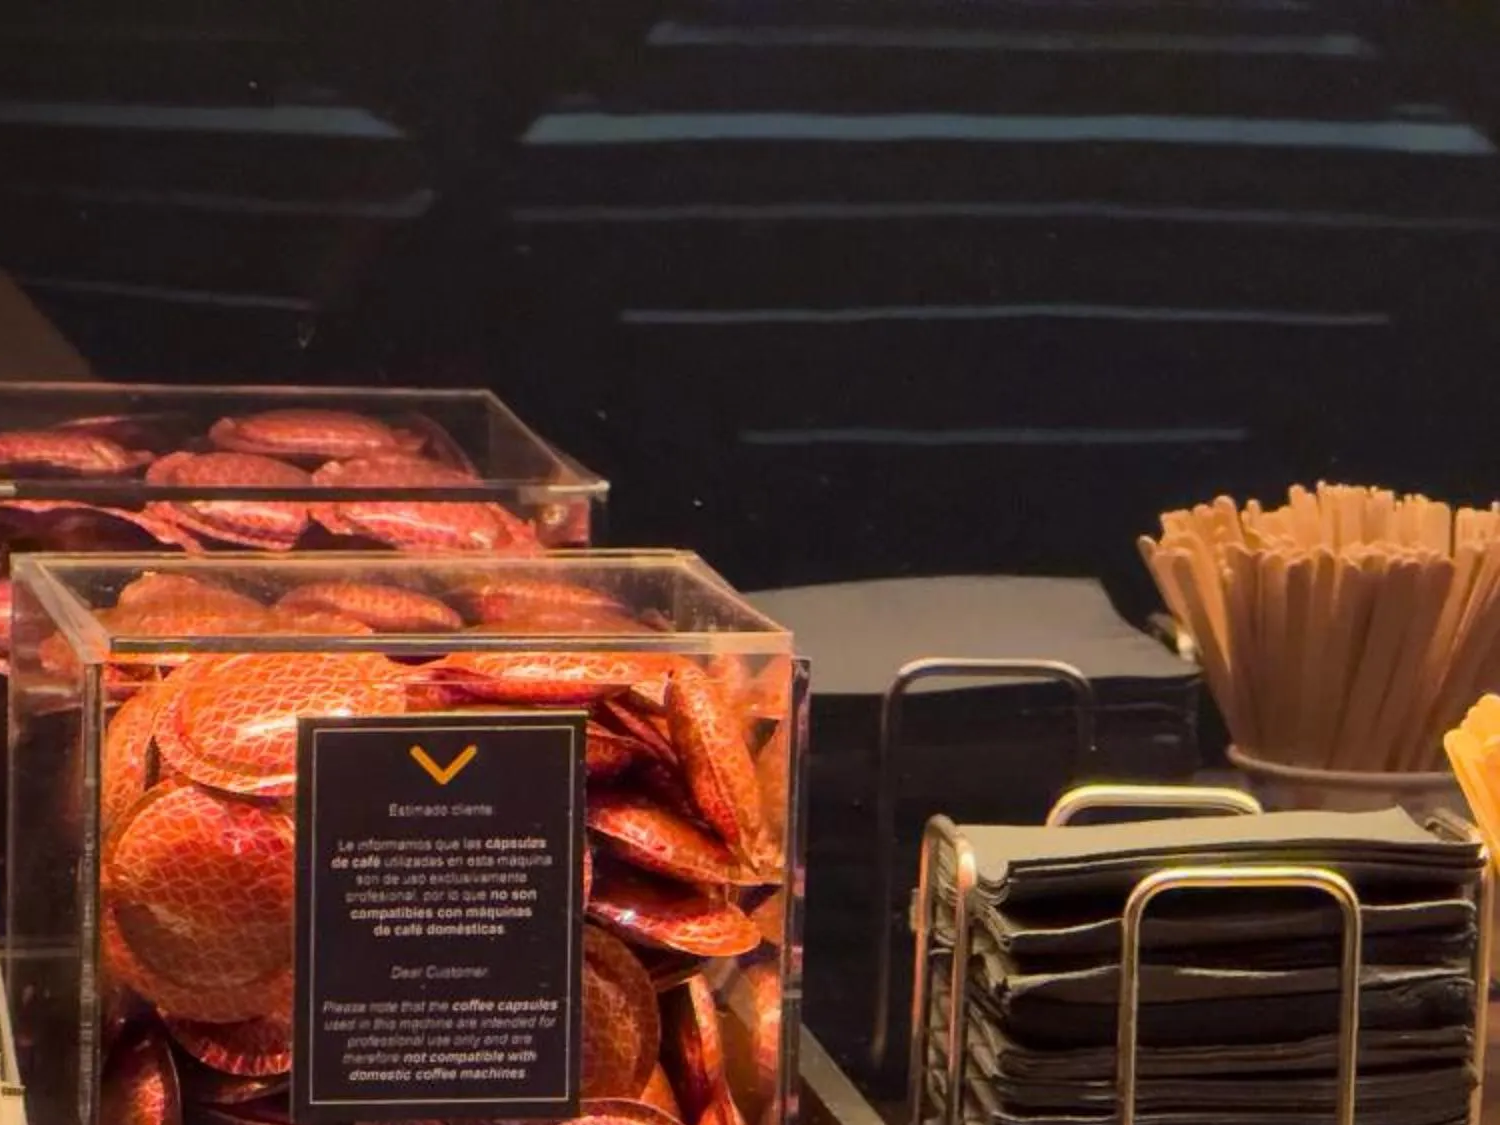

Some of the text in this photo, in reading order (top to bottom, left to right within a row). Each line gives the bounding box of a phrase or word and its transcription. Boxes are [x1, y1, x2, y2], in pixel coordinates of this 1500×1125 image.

[389, 804, 448, 816] Estimado
[358, 839, 431, 852] informamos
[435, 839, 459, 852] que
[485, 837, 547, 851] cápsulas
[331, 854, 552, 869] de café utilizadas en esta máquina
[356, 872, 527, 885] son de uso exclusivamente
[423, 892, 444, 903] por
[463, 891, 486, 902] que
[490, 890, 508, 900] no
[512, 890, 537, 900] son
[351, 906, 532, 921] compatibles con máquinas
[373, 923, 390, 936] de
[395, 923, 423, 936] café
[390, 965, 423, 979] Dear
[323, 999, 557, 1013] Please note that the coffee capsules
[324, 1018, 355, 1031] used
[373, 1018, 396, 1030] this
[400, 1018, 452, 1030] machine
[456, 1018, 477, 1029] are
[480, 1016, 535, 1029] intended
[538, 1016, 556, 1028] for
[348, 1034, 532, 1049] professional use only and are
[343, 1051, 537, 1064] therefore not compatible with
[349, 1069, 410, 1081] domestic
[416, 1068, 457, 1080] coffee
